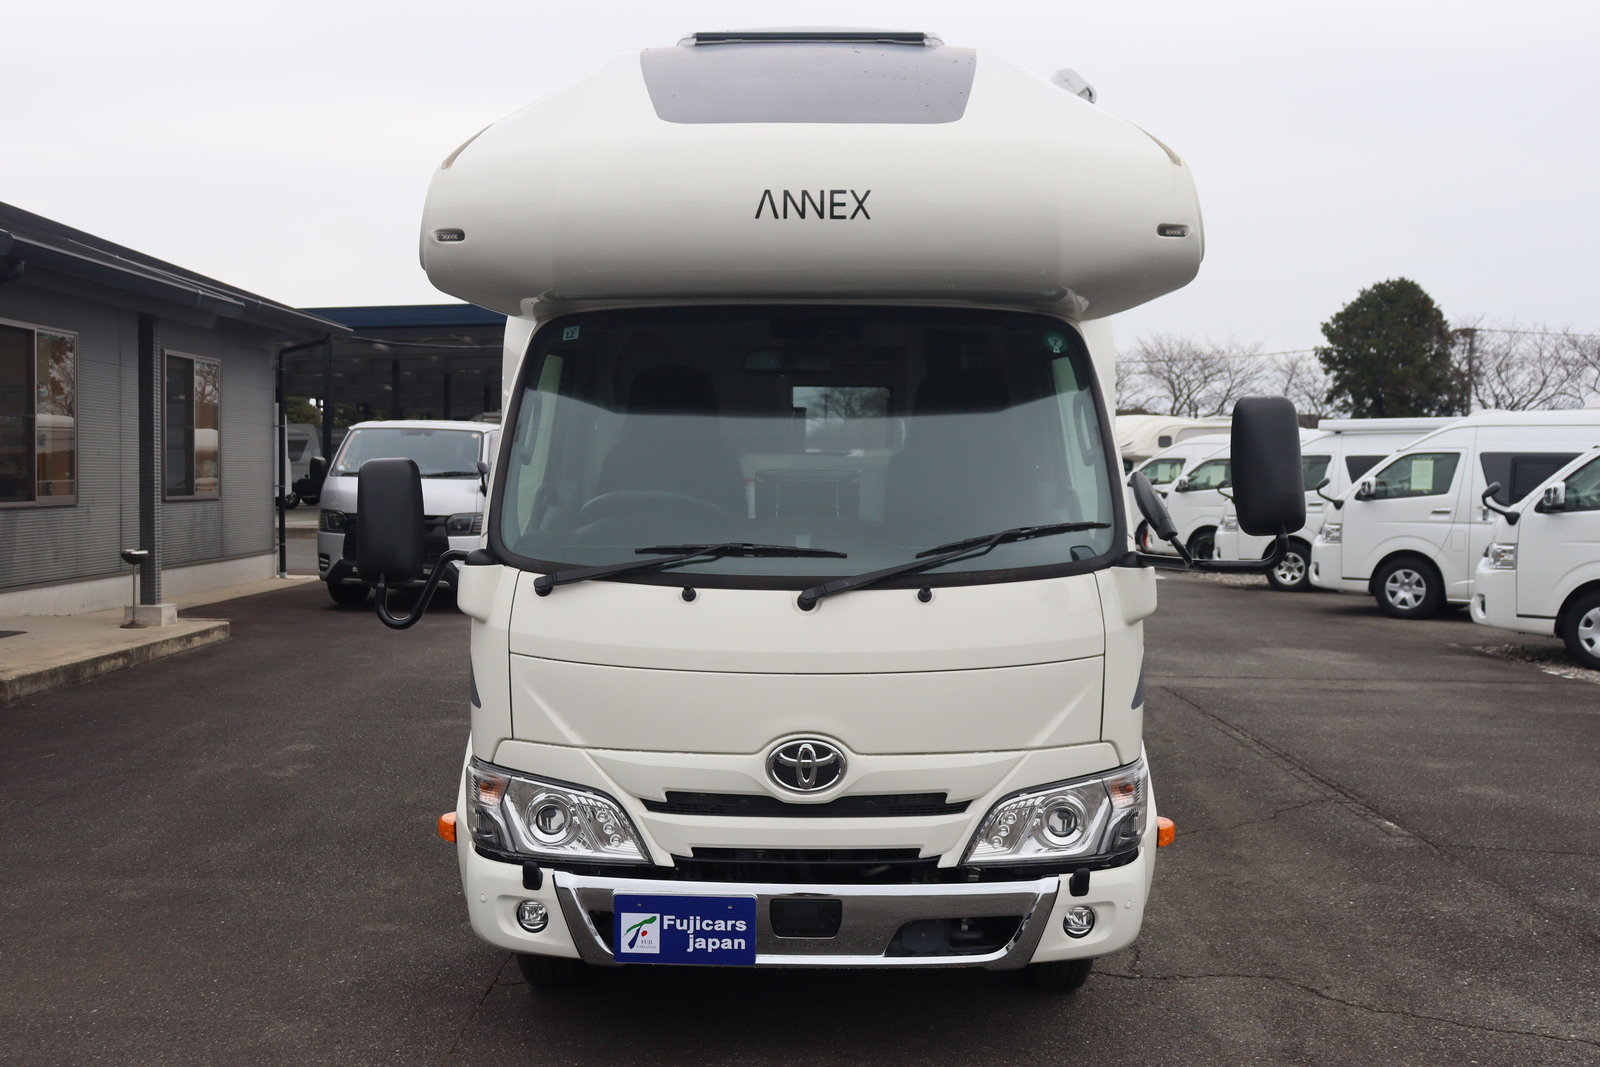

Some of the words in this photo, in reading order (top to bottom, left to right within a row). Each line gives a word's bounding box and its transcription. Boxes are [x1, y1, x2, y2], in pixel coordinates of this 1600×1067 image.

[755, 189, 871, 220] ANNEX
[663, 915, 747, 934] Fujicars
[687, 934, 746, 952] japan
